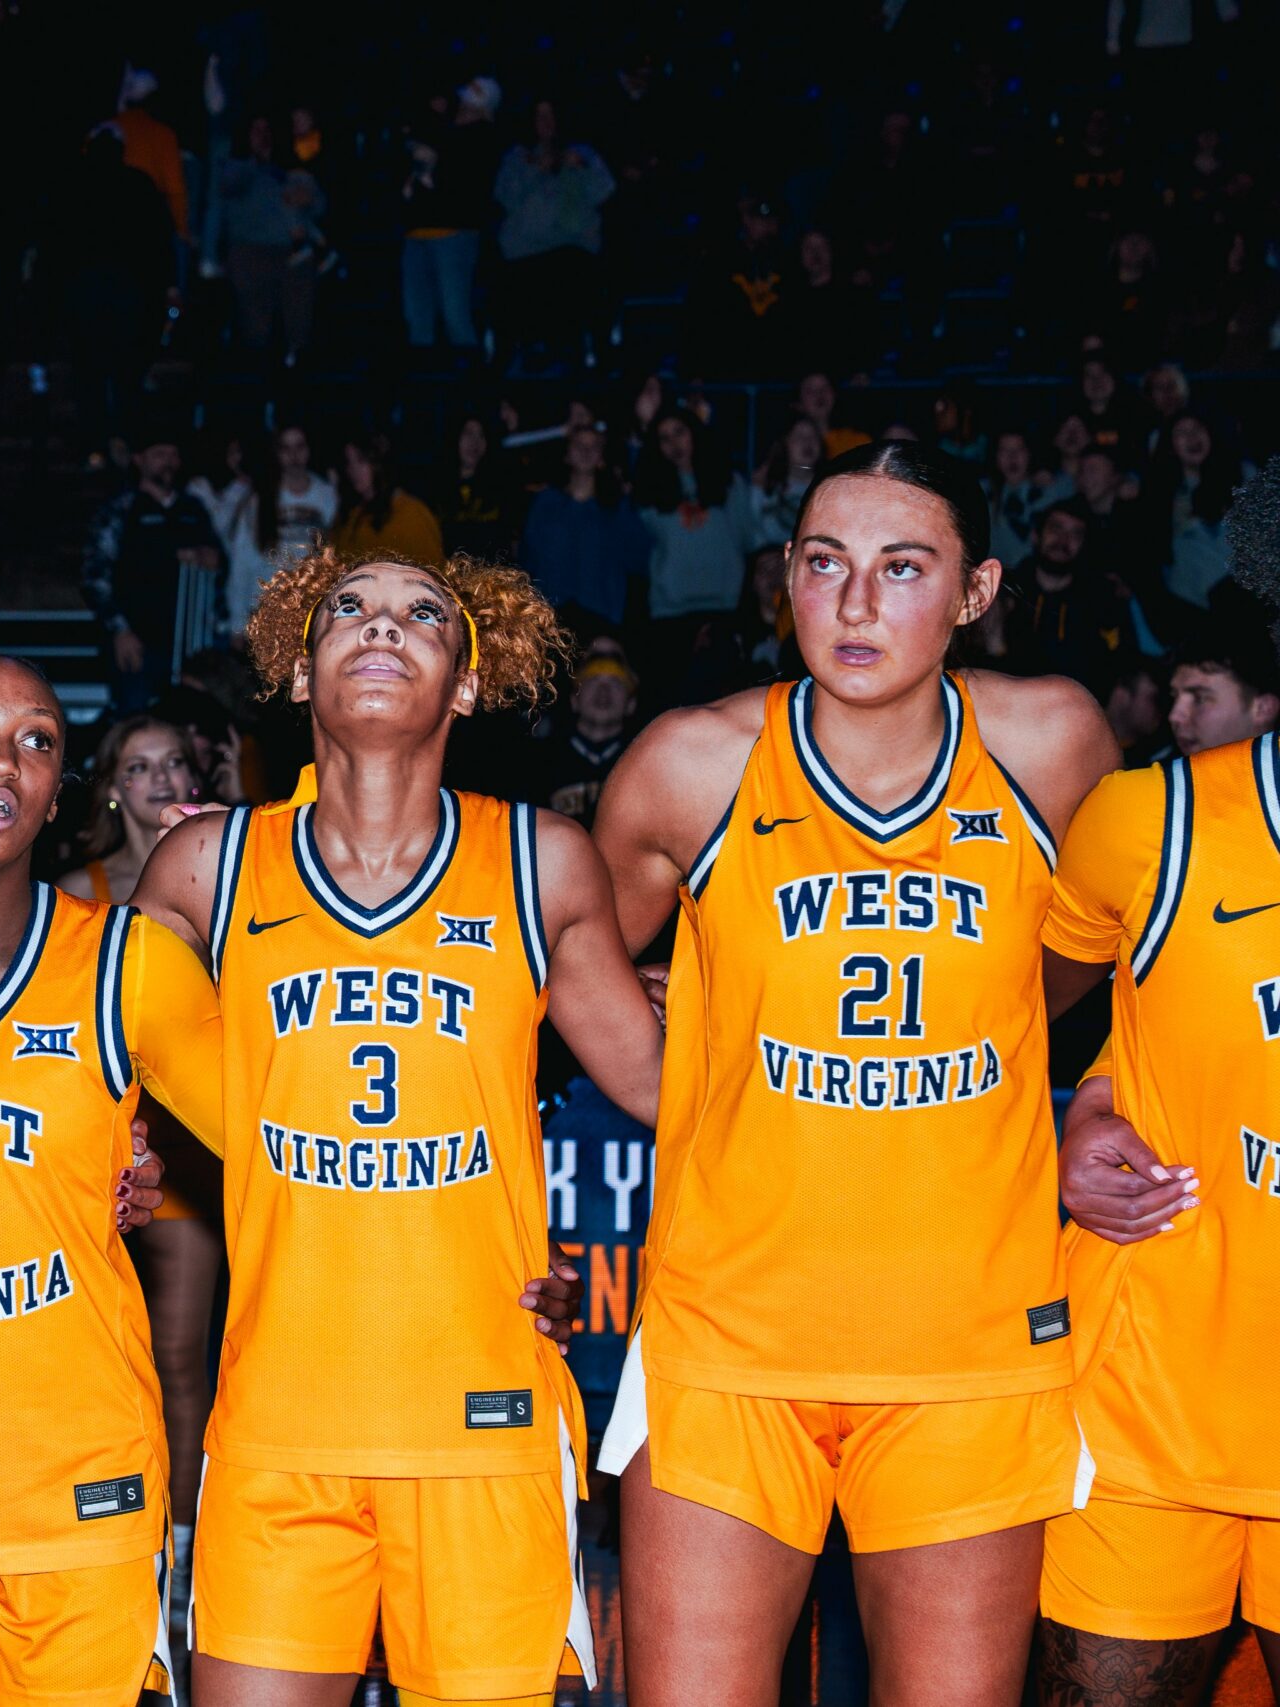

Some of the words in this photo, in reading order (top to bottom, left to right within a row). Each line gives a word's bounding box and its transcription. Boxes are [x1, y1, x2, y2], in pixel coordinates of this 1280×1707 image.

[947, 809, 1007, 843] XII
[437, 913, 495, 951] XII
[775, 871, 987, 943] WEST
[269, 967, 473, 1044] WEST
[839, 954, 924, 1038] 21
[13, 1022, 79, 1061] XII
[760, 1034, 1001, 1110] VIRGINIA
[350, 1042, 398, 1127] 3
[261, 1117, 491, 1191] VIRGINIA
[516, 1401, 526, 1416] S
[126, 1487, 136, 1501] S
